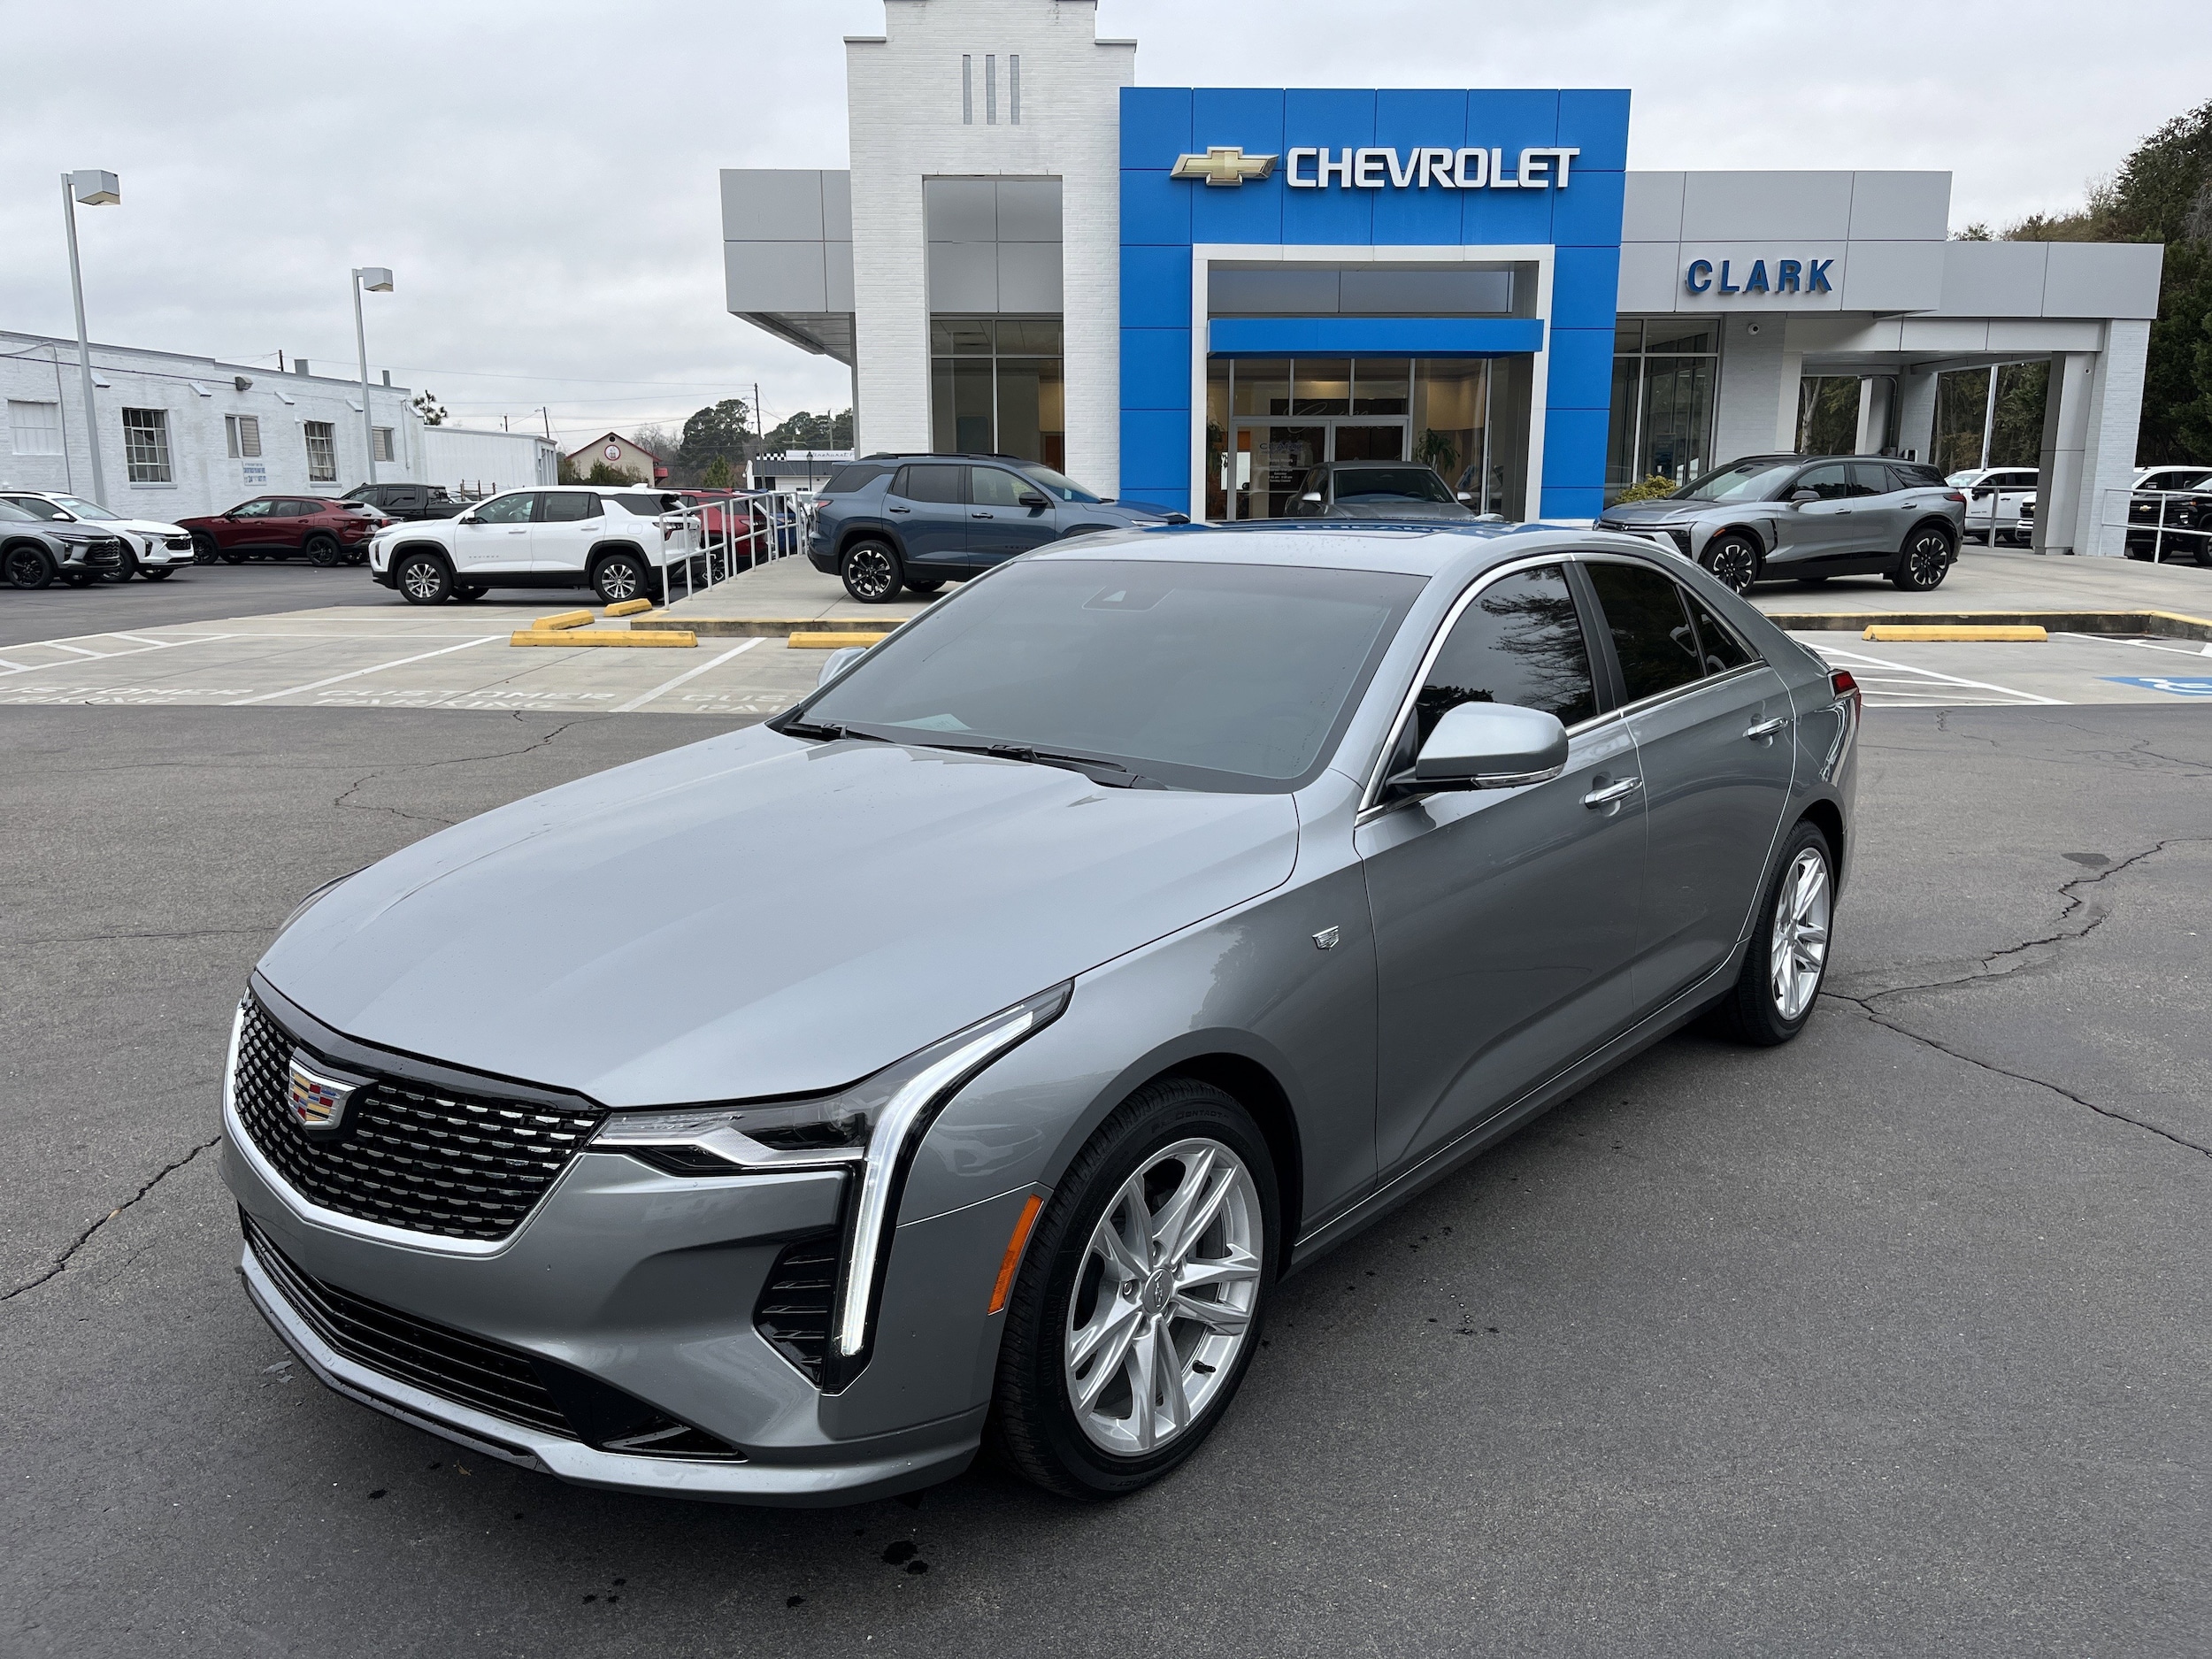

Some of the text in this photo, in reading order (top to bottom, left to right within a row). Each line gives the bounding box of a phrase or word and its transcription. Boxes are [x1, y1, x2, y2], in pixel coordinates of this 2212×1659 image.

[1286, 147, 1580, 188] CHEVROLET
[1685, 259, 1835, 293] CLARK
[314, 699, 554, 709] PARKING
[317, 690, 615, 700] CUSTOMER
